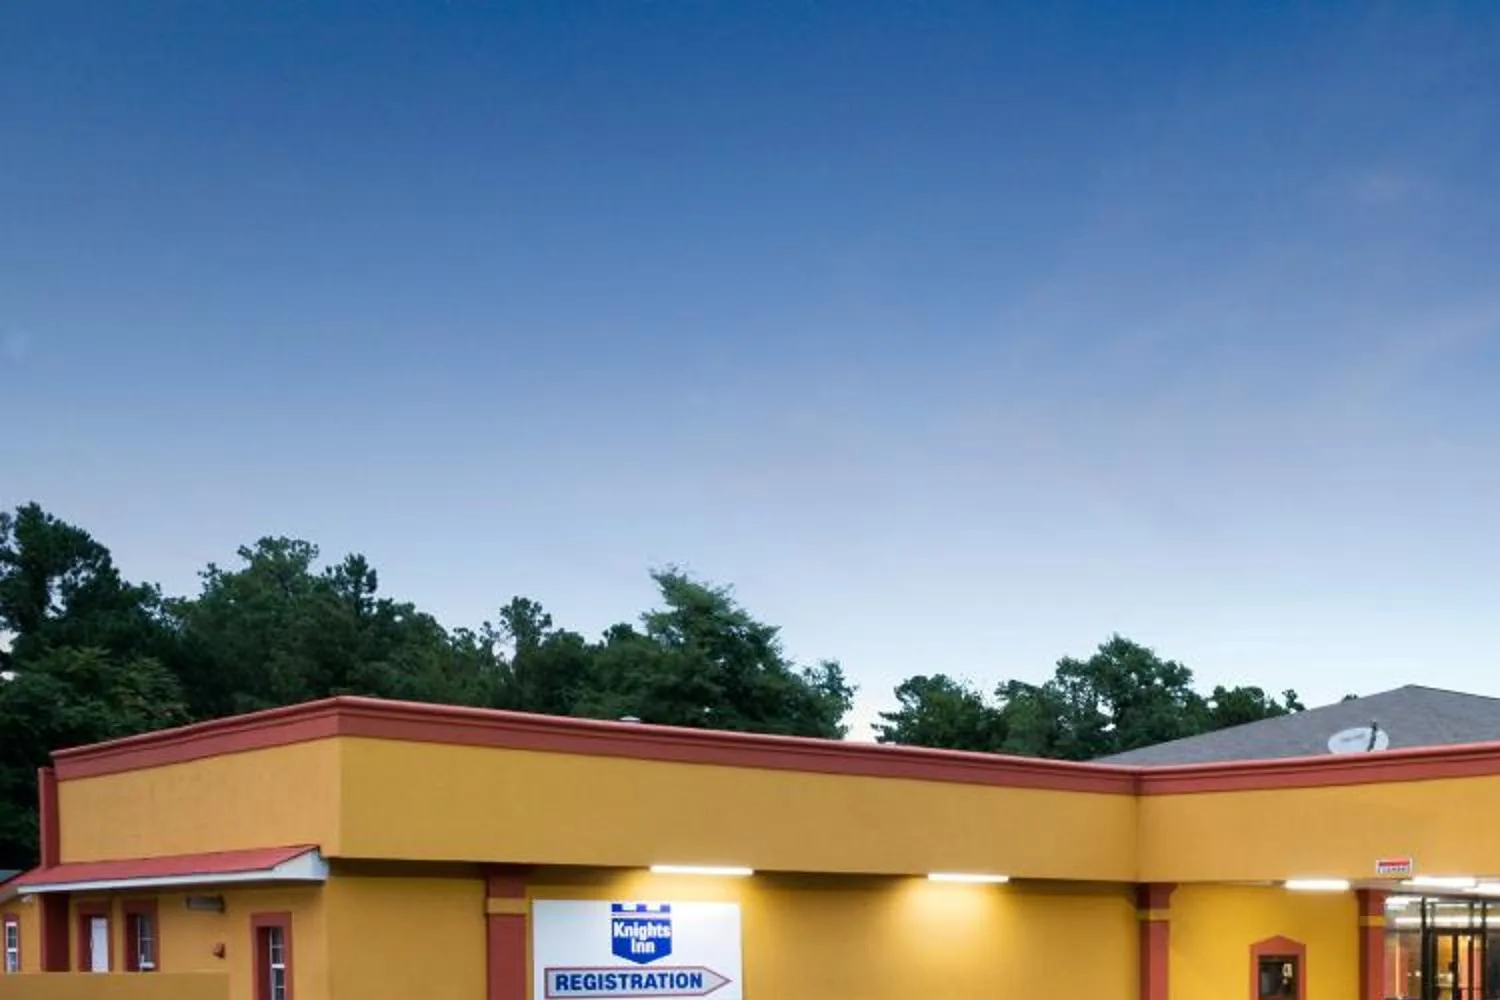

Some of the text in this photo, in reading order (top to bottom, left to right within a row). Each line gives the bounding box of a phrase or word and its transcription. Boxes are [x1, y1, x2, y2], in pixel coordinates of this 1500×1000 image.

[613, 921, 670, 940] Knights
[631, 937, 655, 953] Inn
[555, 973, 703, 991] REGISTRATION
